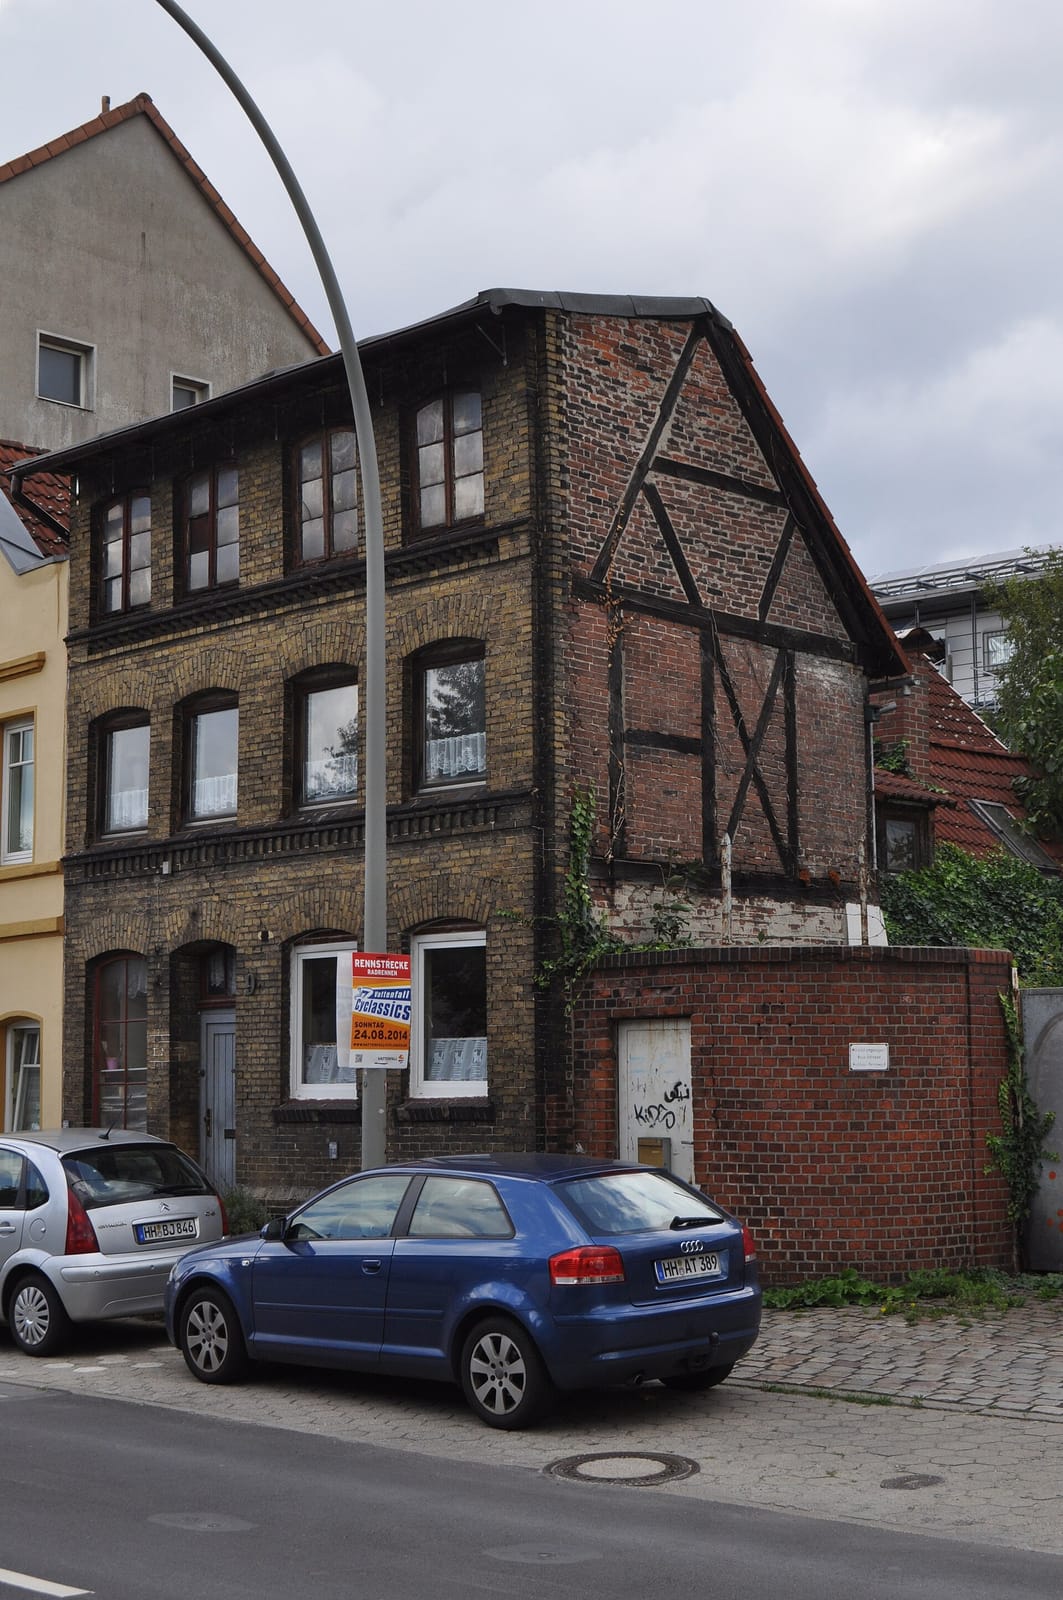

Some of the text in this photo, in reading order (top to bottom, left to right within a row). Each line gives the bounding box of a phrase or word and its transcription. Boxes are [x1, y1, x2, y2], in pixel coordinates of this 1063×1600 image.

[354, 958, 409, 970] RENNSTRECKE
[367, 969, 398, 977] RADRENNEN
[374, 989, 410, 1000] Vattenfall
[354, 998, 412, 1021] Cyclassics
[354, 1021, 385, 1029] SONNTAG
[354, 1030, 408, 1040] 24.08.2014
[143, 1224, 157, 1239] HH
[163, 1223, 175, 1236] BJ
[177, 1221, 194, 1234] 846
[662, 1255, 717, 1277] HH AT 389
